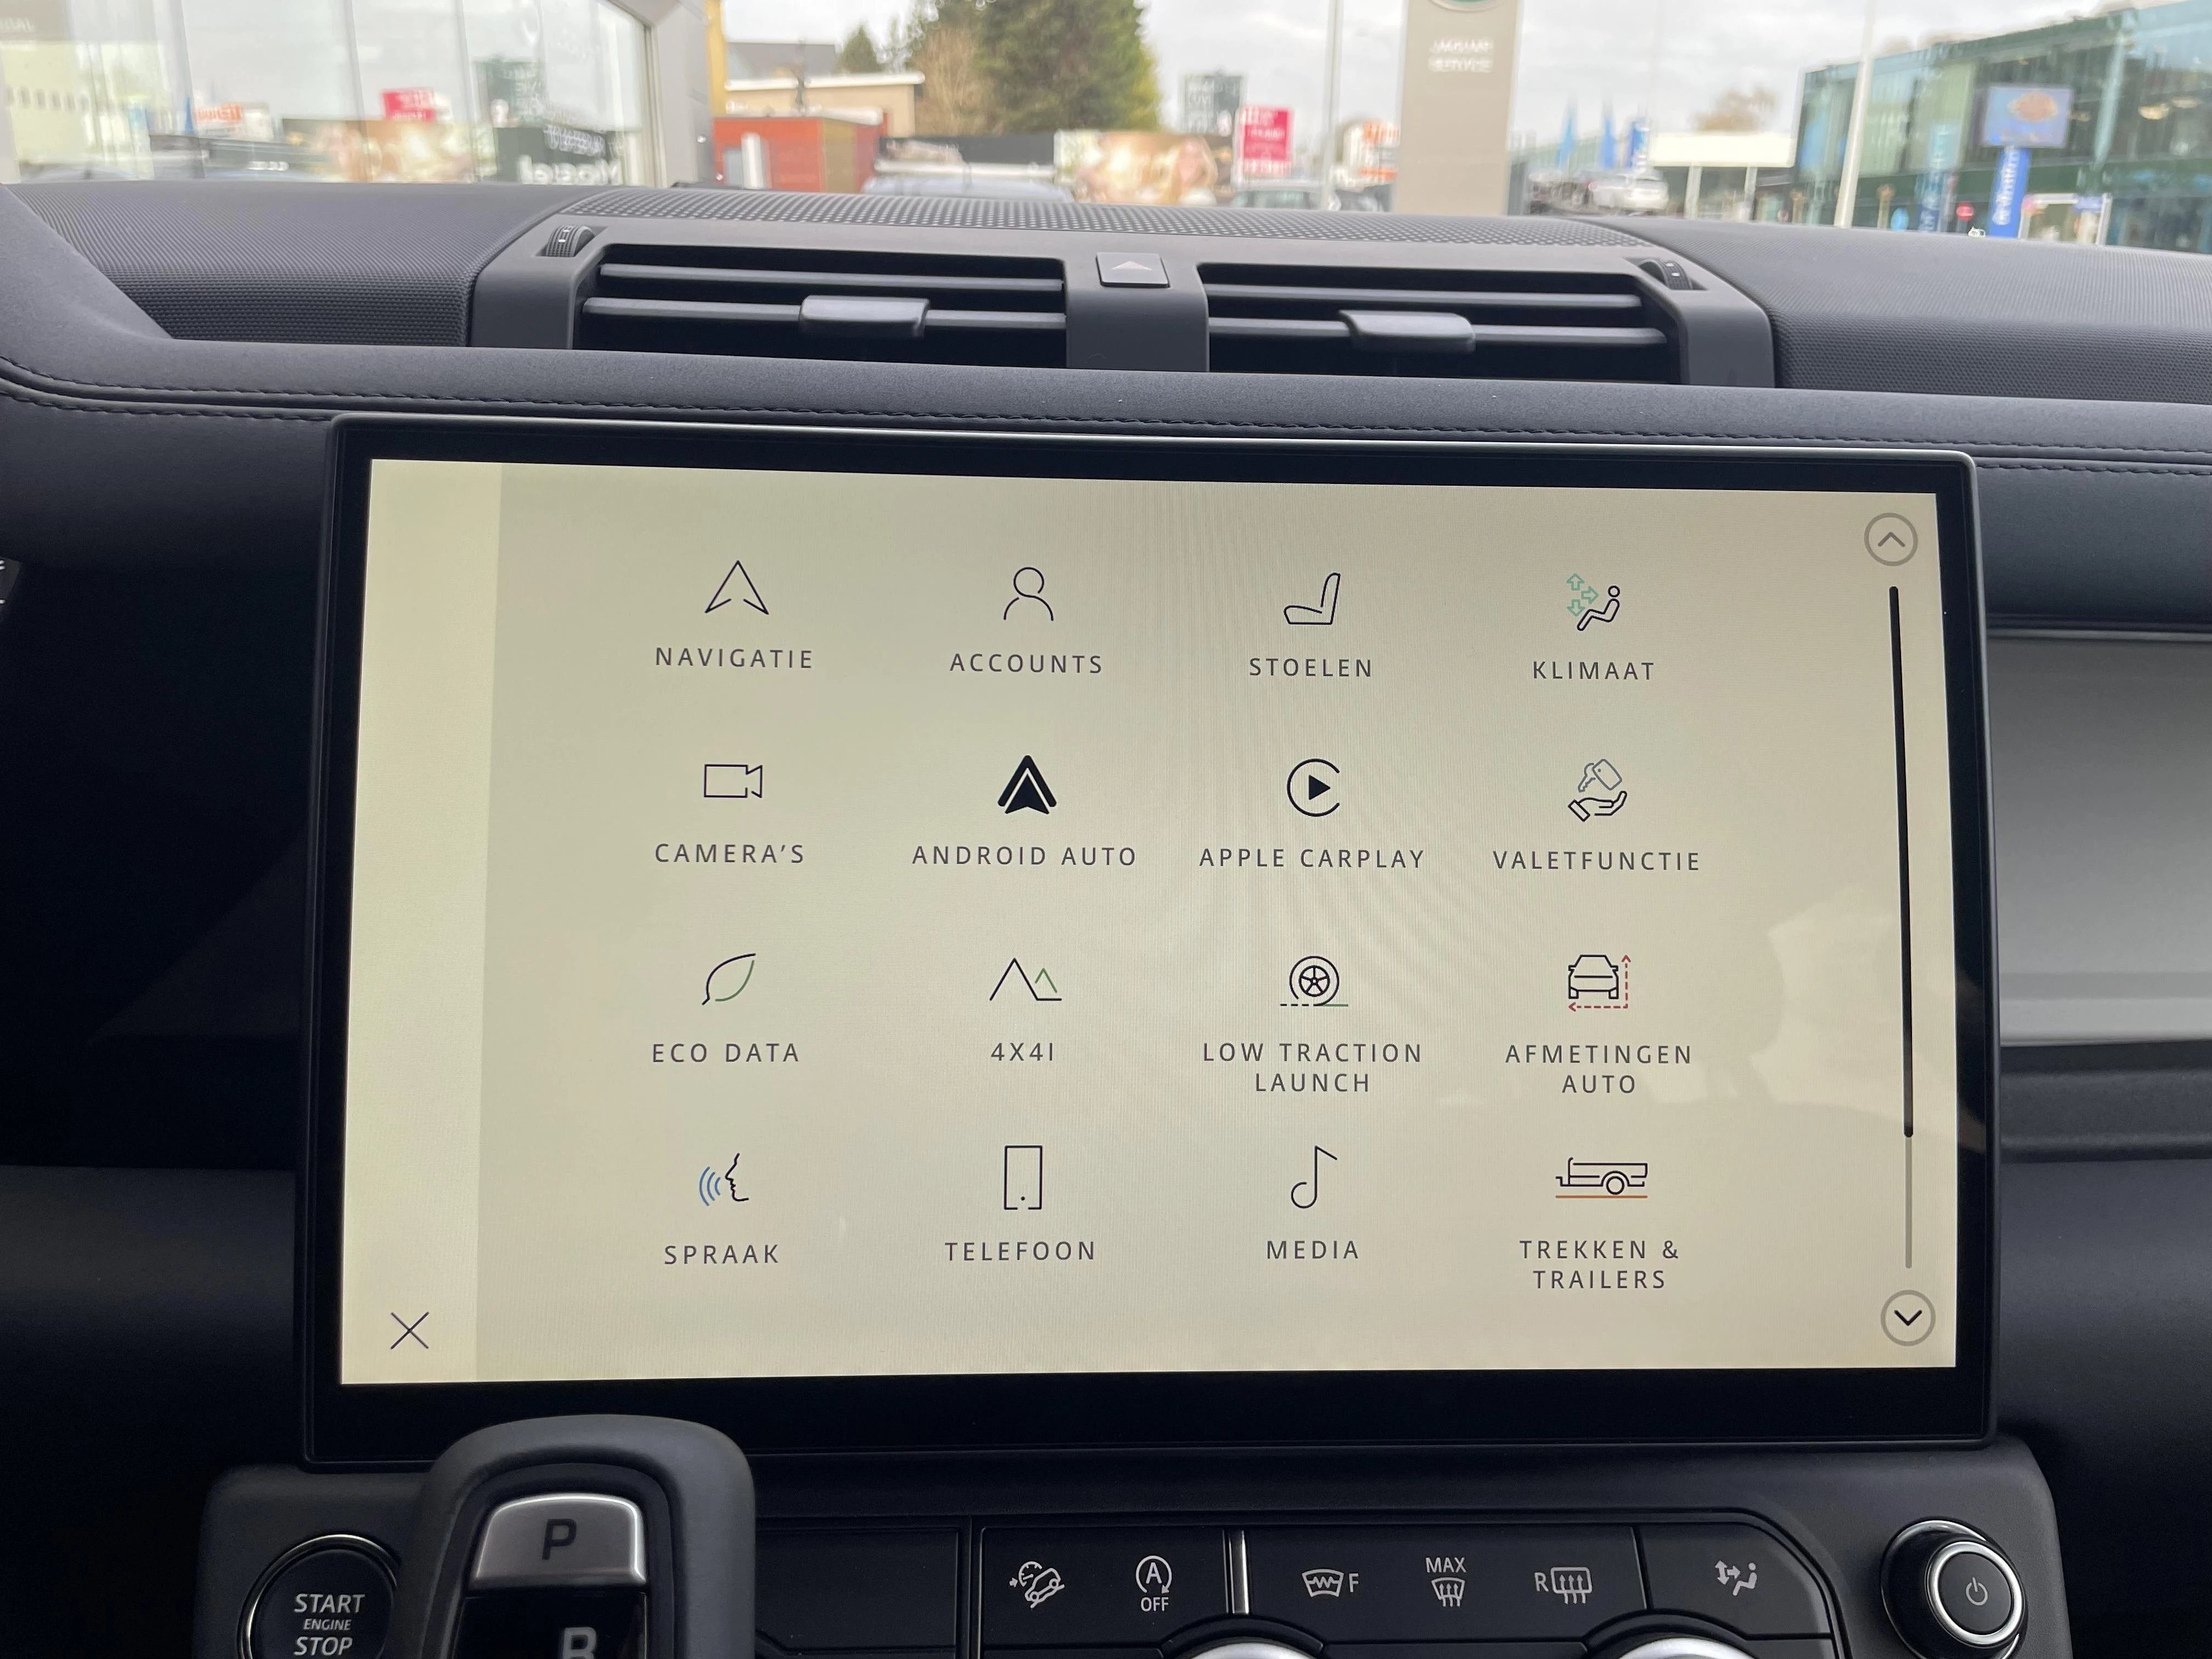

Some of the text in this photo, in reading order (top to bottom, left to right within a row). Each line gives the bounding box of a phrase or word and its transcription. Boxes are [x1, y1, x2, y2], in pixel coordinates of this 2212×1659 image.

[656, 647, 811, 669] NAVIGATIE
[950, 653, 1101, 674] ACCOUNTS
[1250, 658, 1370, 677] STOELEN
[1533, 661, 1654, 680] KLIMAAT
[656, 843, 803, 864] CAMERA'S
[912, 846, 1135, 866] ANDROID AUTO
[1199, 848, 1424, 868] APPLE CARPLAY
[1493, 851, 1699, 871] VALETFUNCTIE
[653, 1043, 799, 1063] ECO DATA
[991, 1042, 1053, 1062] 4X4I
[1204, 1042, 1420, 1063] LOW TRACTION
[1505, 1045, 1690, 1064] AFMETINGEN
[1256, 1073, 1368, 1092] LAUNCH
[1562, 1075, 1635, 1093] AUTO
[664, 1244, 778, 1265] SPRAAK
[944, 1241, 1093, 1261] TELEFOON
[1267, 1240, 1358, 1259] MEDIA
[1519, 1240, 1679, 1259] TREKKEN &
[1533, 1270, 1664, 1289] TRAILERS
[541, 1518, 577, 1560] P
[1146, 1562, 1162, 1584] A
[1425, 1557, 1466, 1573] MAX
[1348, 1573, 1359, 1593] F
[1534, 1572, 1548, 1592] R
[294, 1593, 365, 1613] START
[1140, 1596, 1169, 1612] OFF
[303, 1618, 352, 1630] ENGINE
[294, 1636, 353, 1656] STOP
